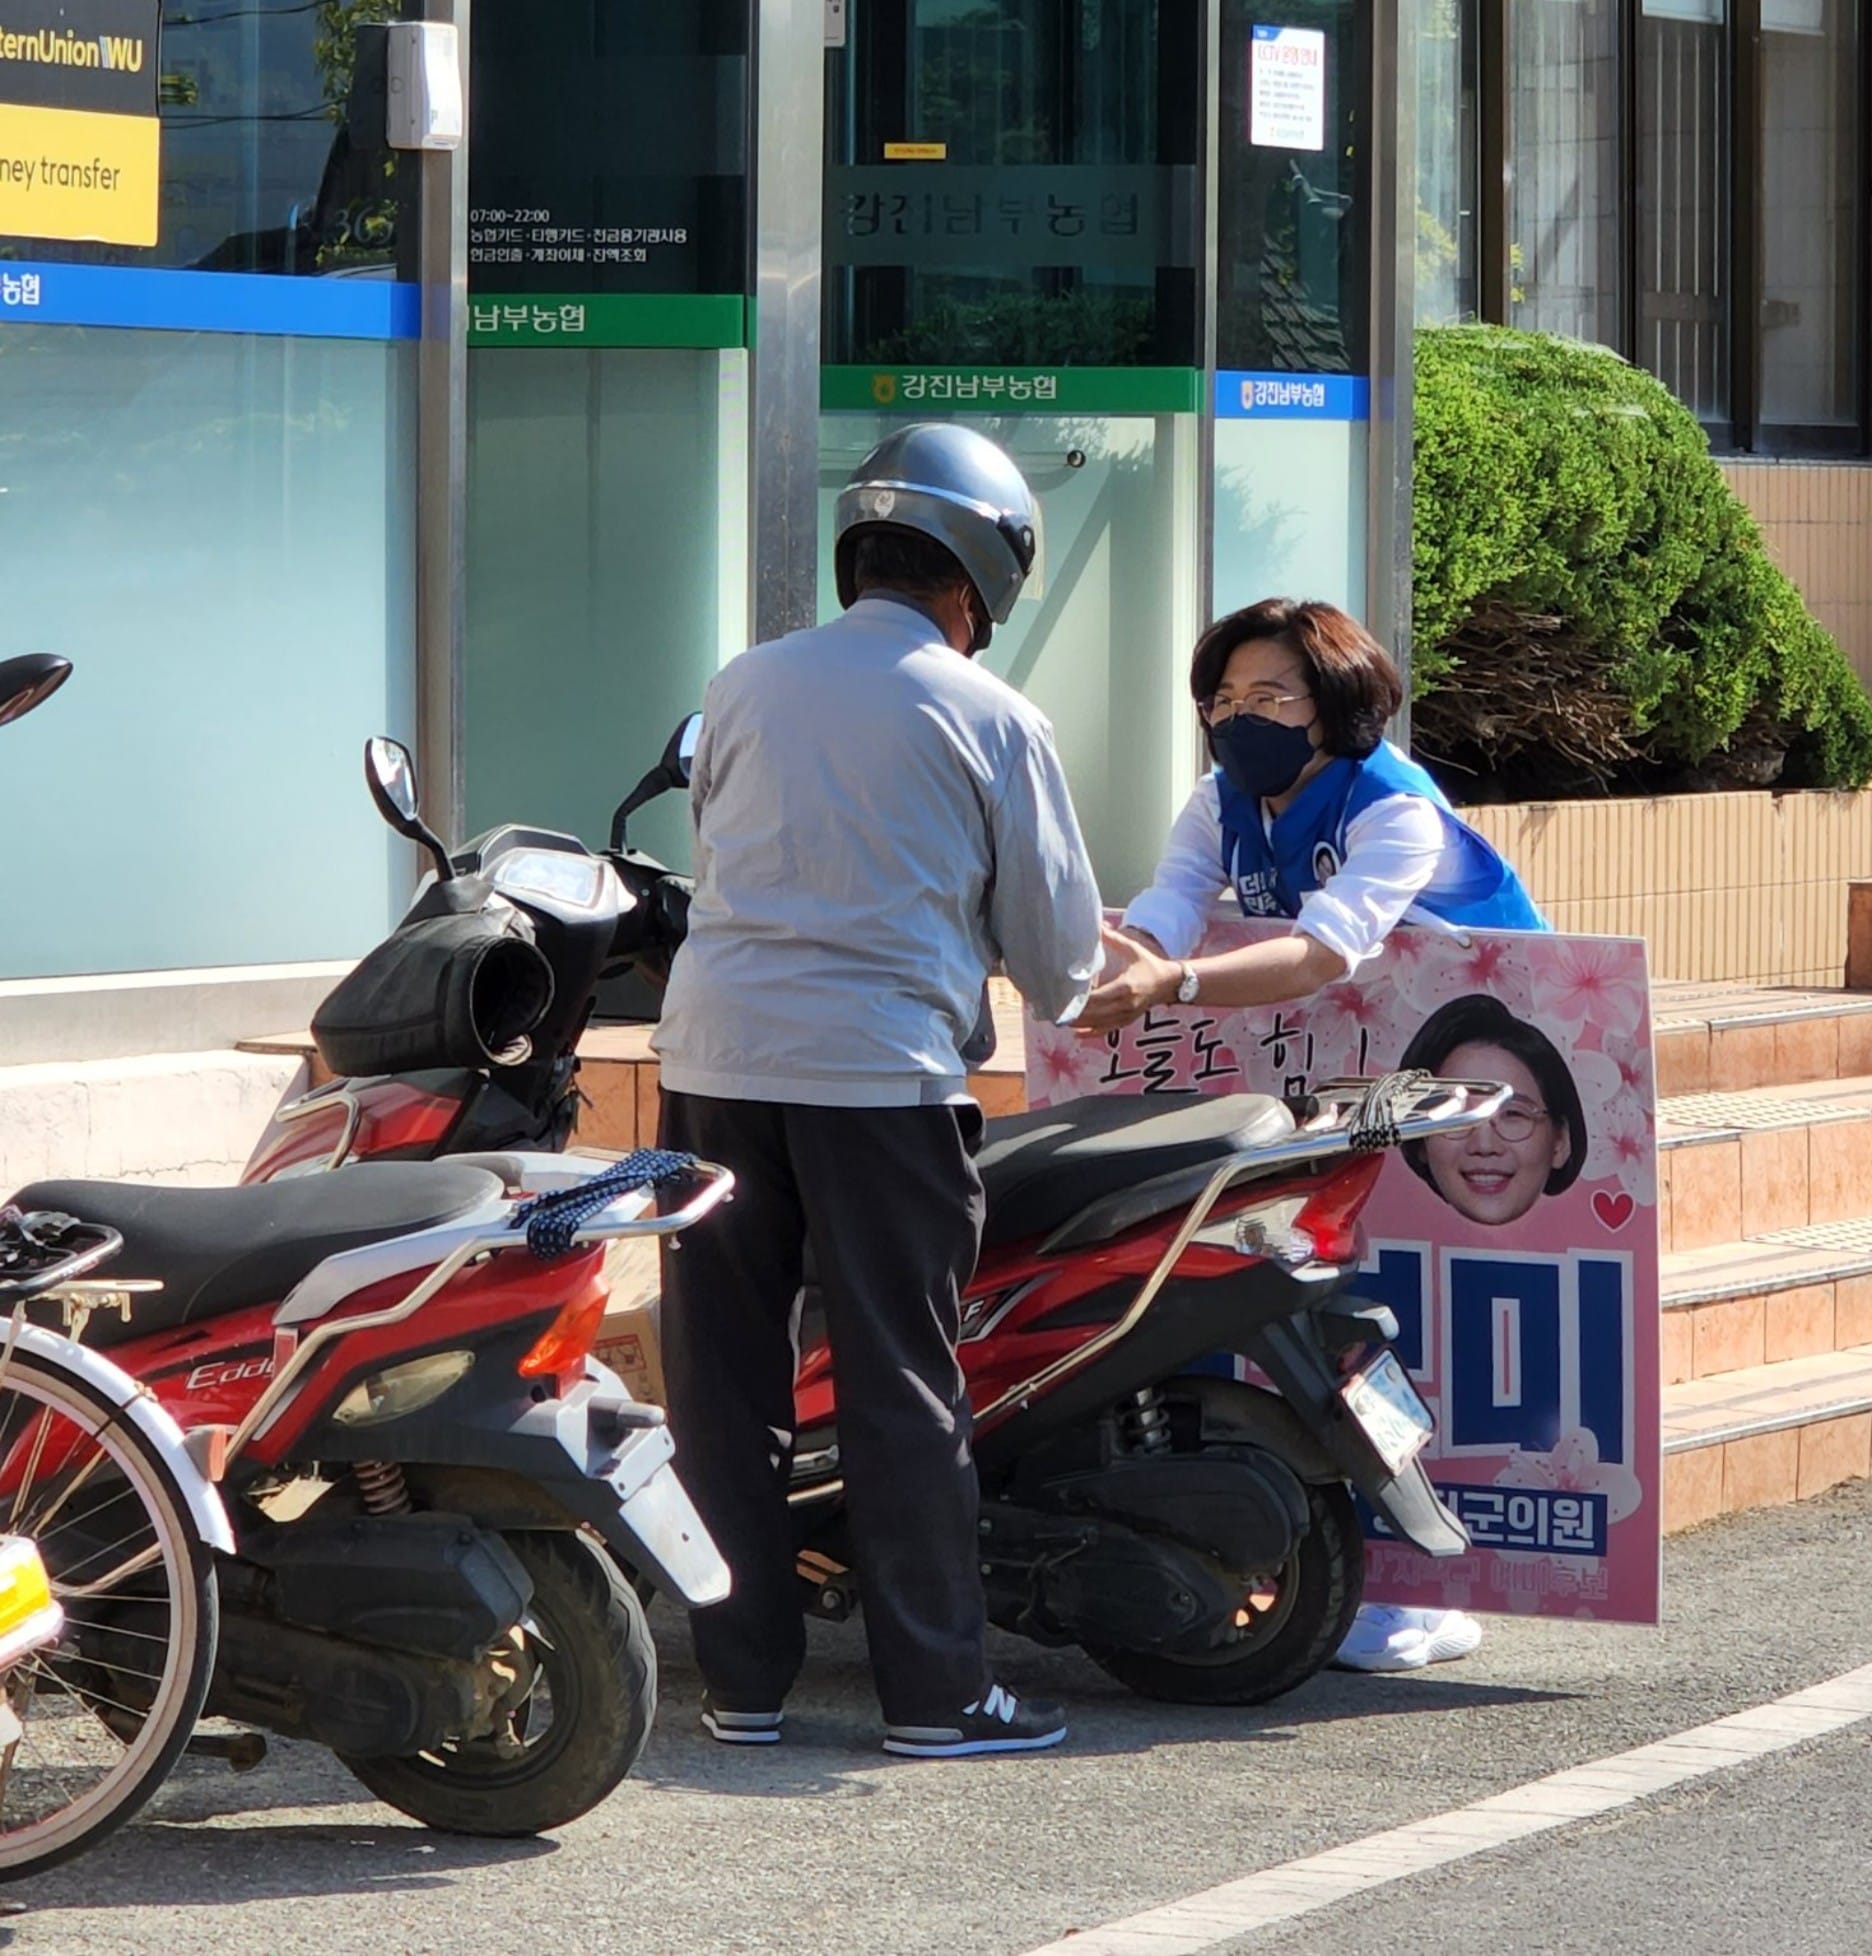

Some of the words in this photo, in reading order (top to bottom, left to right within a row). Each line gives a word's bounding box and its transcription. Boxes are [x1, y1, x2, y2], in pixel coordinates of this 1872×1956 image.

[40, 156, 120, 191] transfer
[470, 209, 550, 223] 07:00~22:00
[466, 304, 586, 333] 남부농협
[902, 375, 1058, 401] 강진남부농협
[1255, 380, 1325, 407] 강진남부농협
[1100, 1011, 1239, 1095] 오늘도
[1436, 1488, 1595, 1550] 군의원
